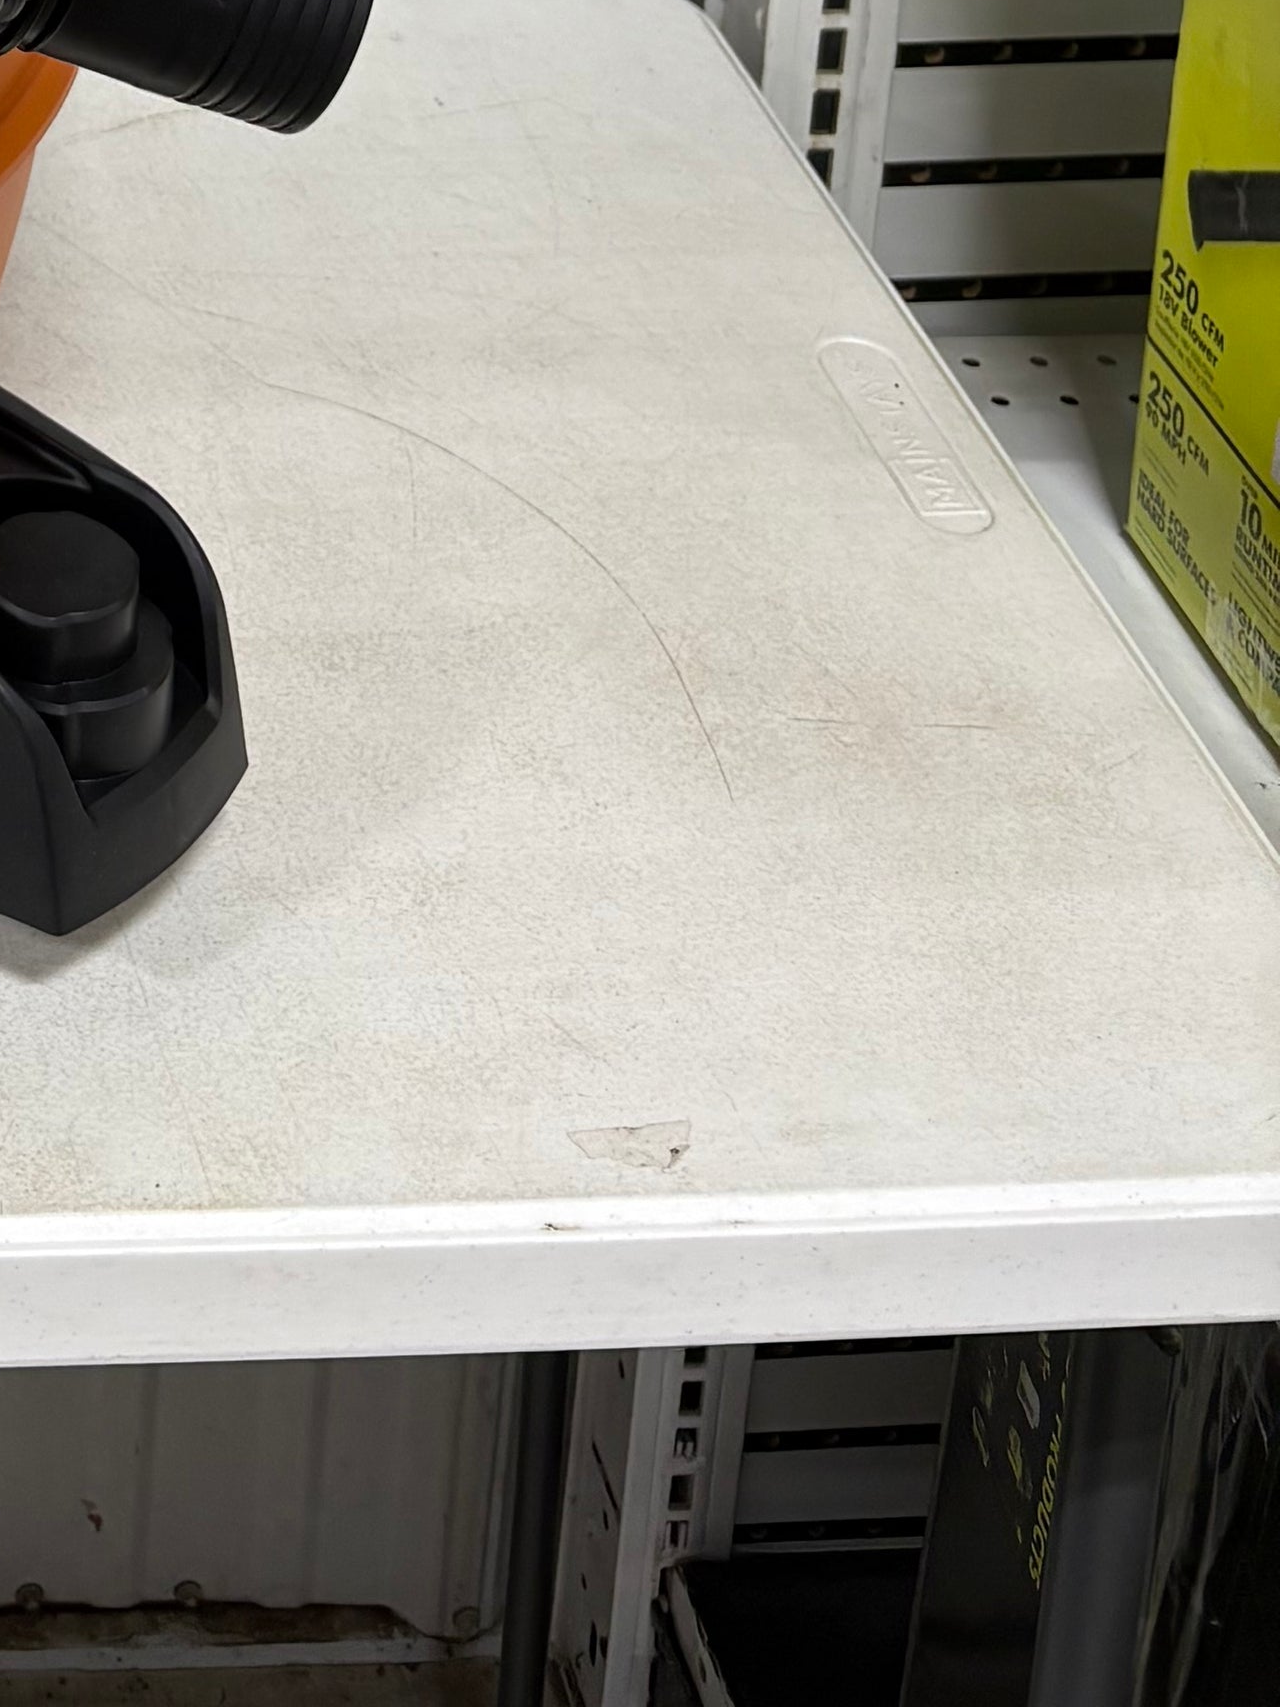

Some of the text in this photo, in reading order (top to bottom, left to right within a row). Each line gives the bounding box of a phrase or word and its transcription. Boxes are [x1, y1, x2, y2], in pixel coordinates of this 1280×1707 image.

[1160, 249, 1199, 316] 250
[1201, 312, 1225, 354] CFM
[1181, 312, 1219, 368] Blower
[1147, 370, 1185, 439] 250
[1187, 434, 1210, 477] CFM
[1240, 488, 1262, 542] 10
